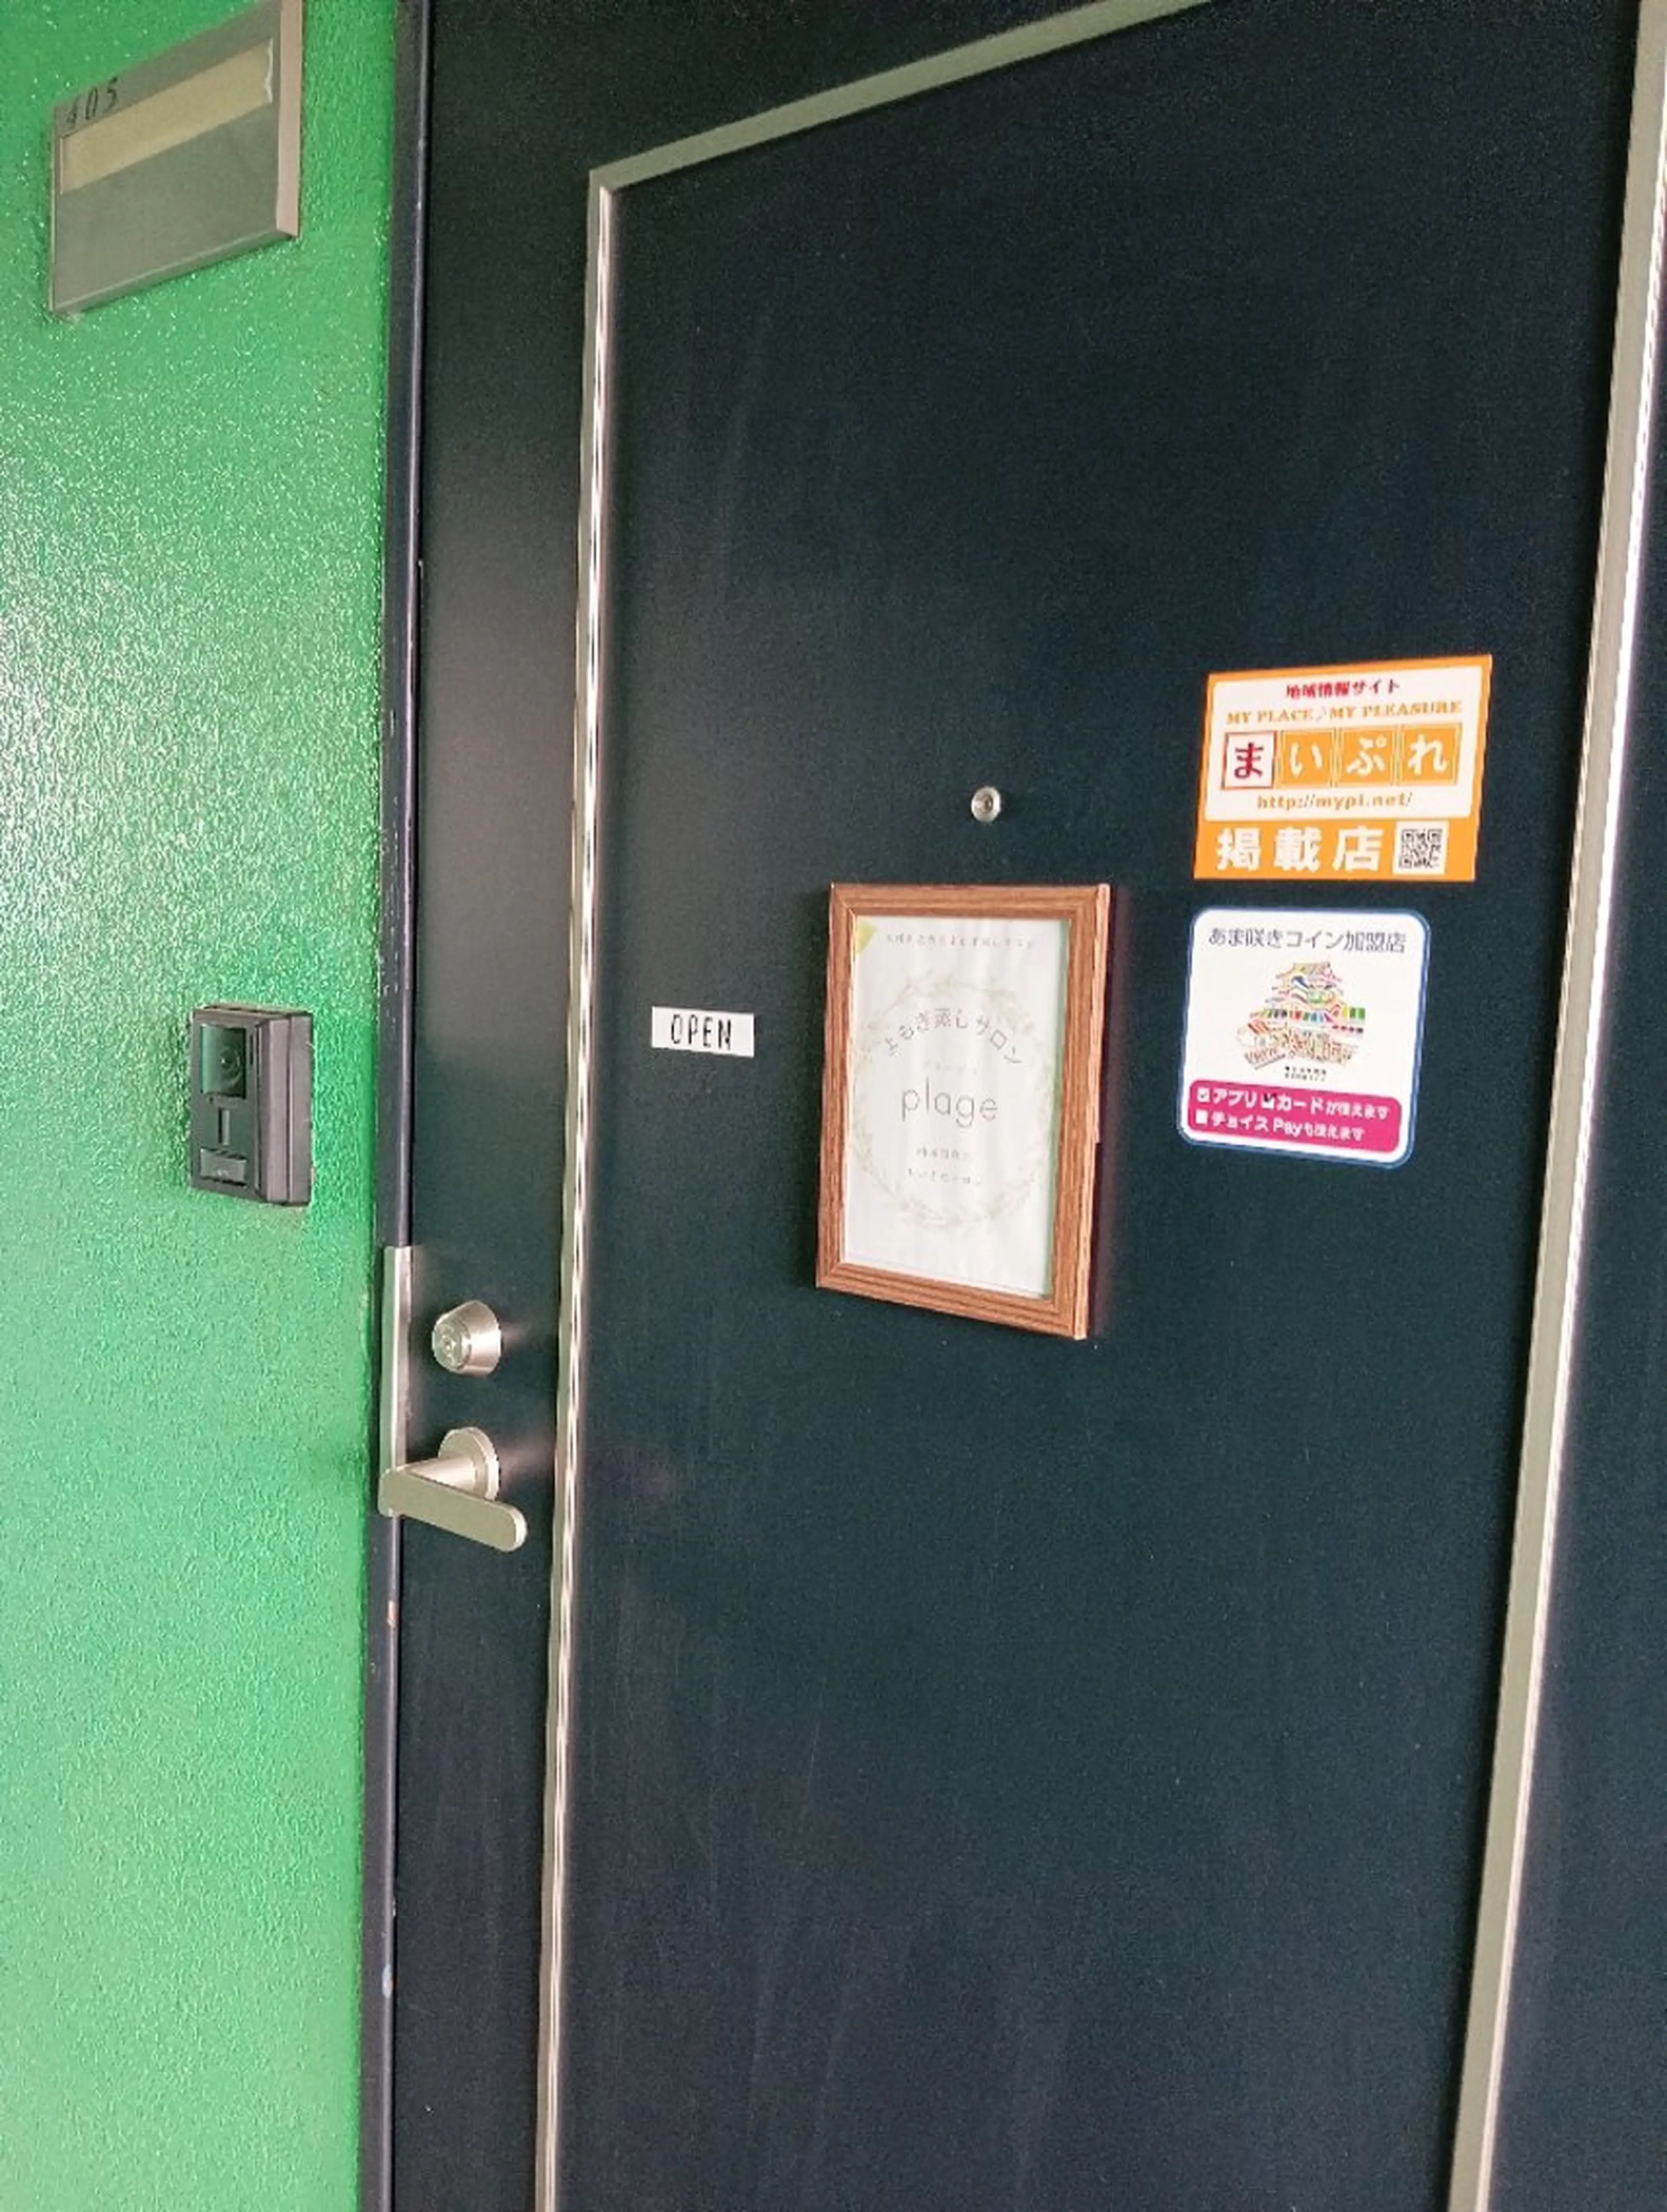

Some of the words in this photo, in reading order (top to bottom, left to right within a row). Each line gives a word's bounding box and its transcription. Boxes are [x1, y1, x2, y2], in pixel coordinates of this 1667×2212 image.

[1286, 678, 1400, 700] 地域情報サイト
[1226, 711, 1252, 725] MY
[1257, 708, 1314, 724] PLACE
[1330, 705, 1357, 721] MY
[1362, 700, 1463, 718] PLEASURE
[1217, 825, 1384, 872] 掲載店
[1208, 927, 1407, 954] あま咲きコイン加盟店
[671, 1014, 731, 1050] OPEN
[901, 1077, 998, 1129] plage
